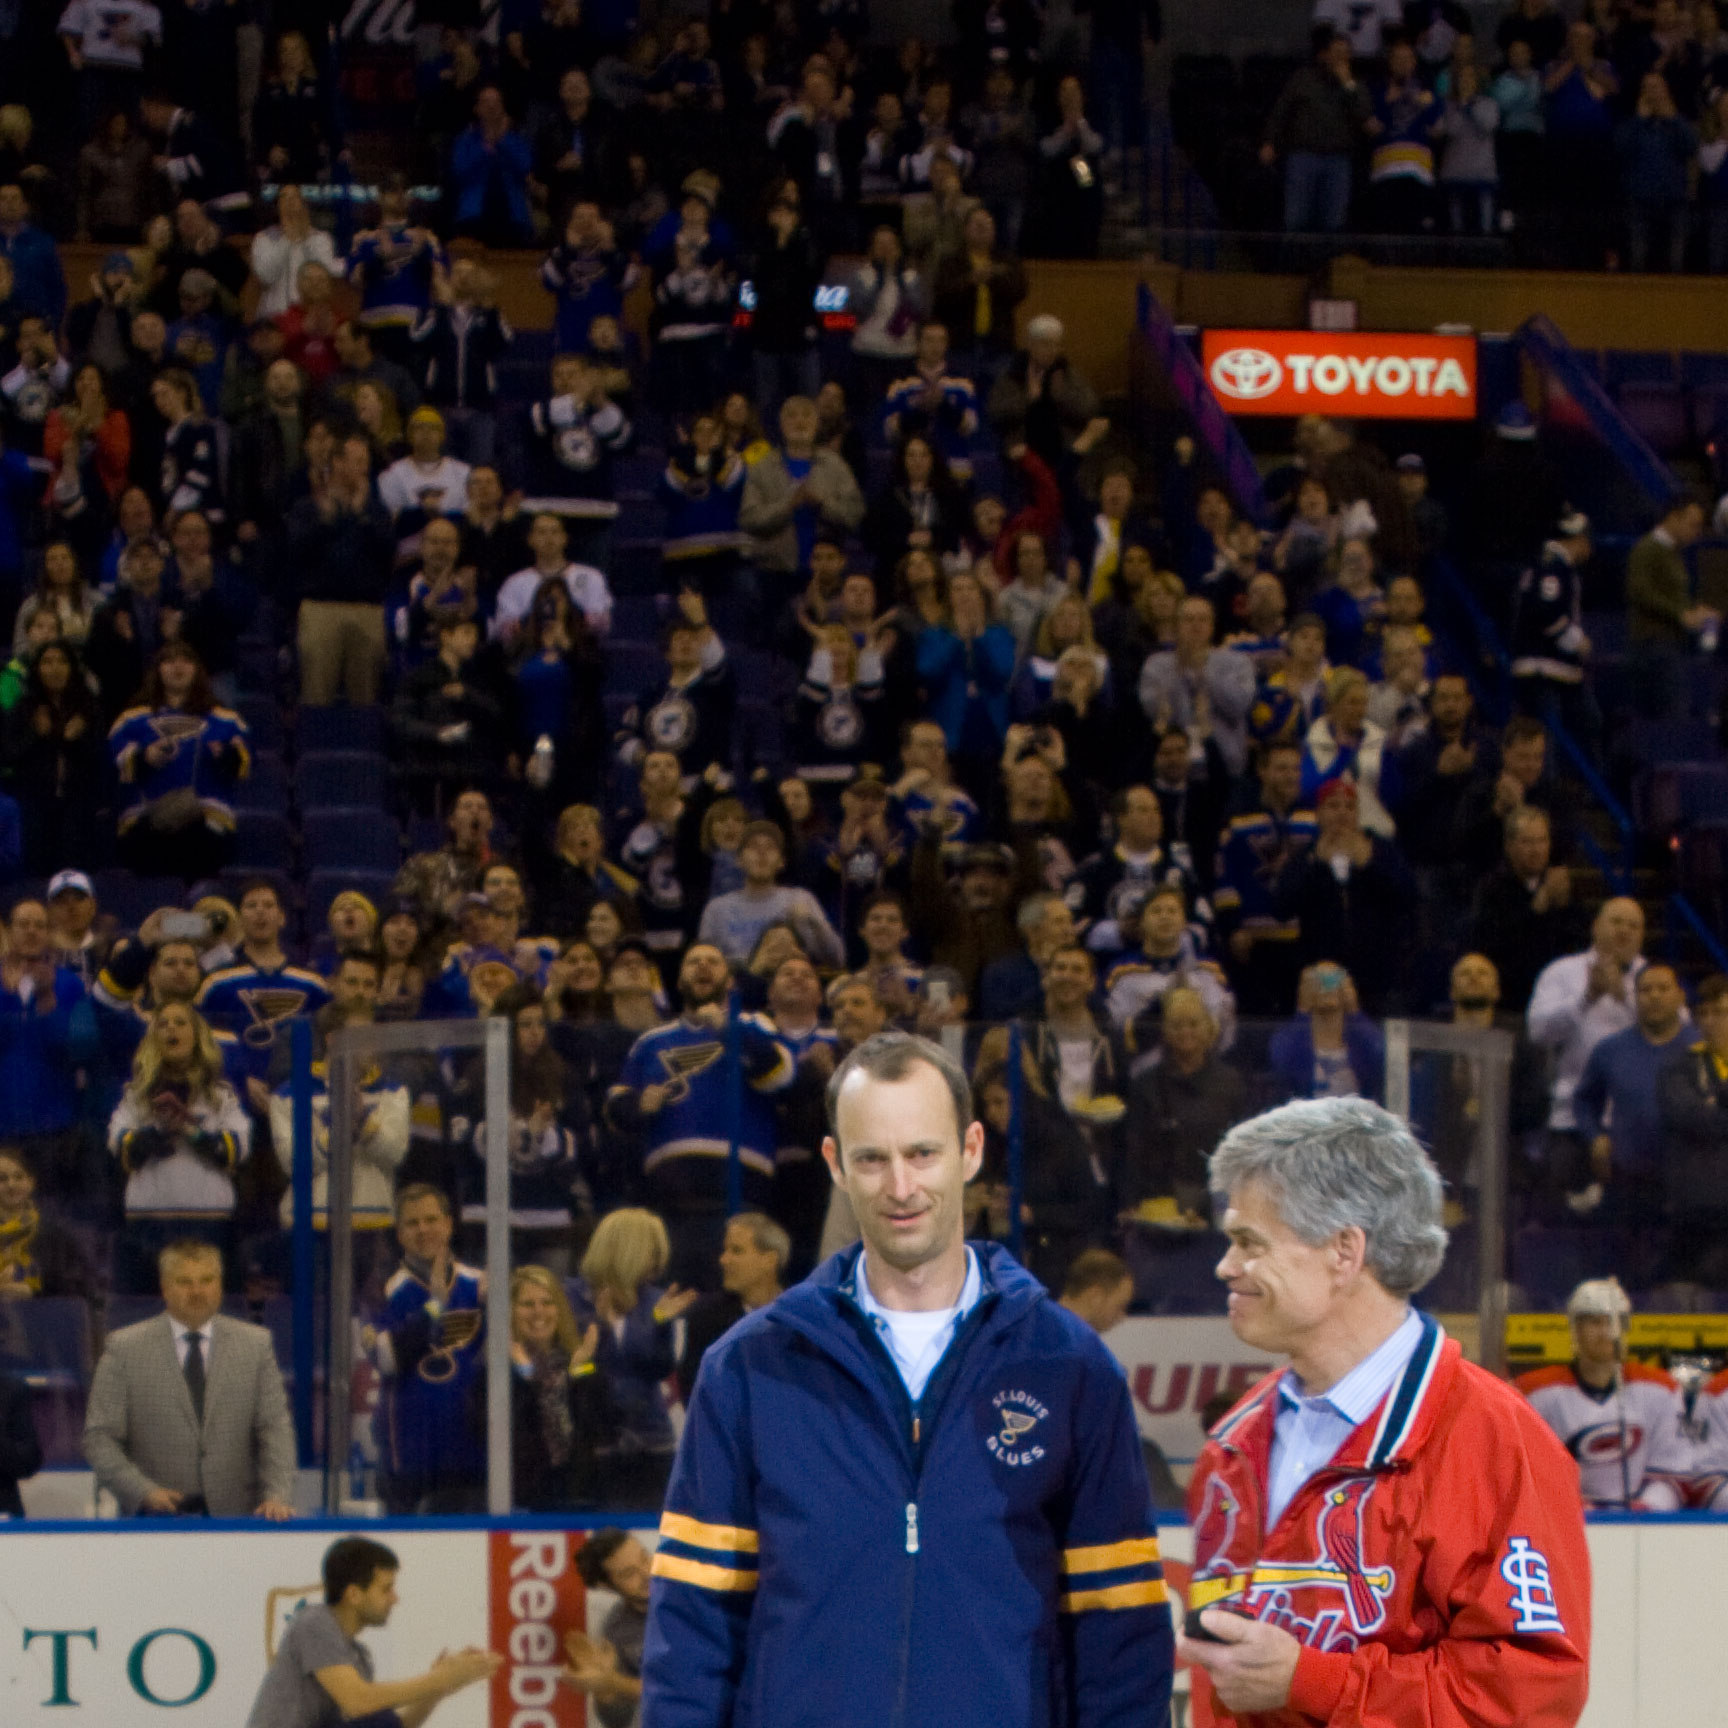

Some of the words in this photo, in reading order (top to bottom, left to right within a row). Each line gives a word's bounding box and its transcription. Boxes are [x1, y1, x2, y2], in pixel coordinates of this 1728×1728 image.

[1284, 353, 1471, 398] TOYOTA
[1008, 1388, 1050, 1421] LOUIS
[985, 1434, 1047, 1468] BLUES
